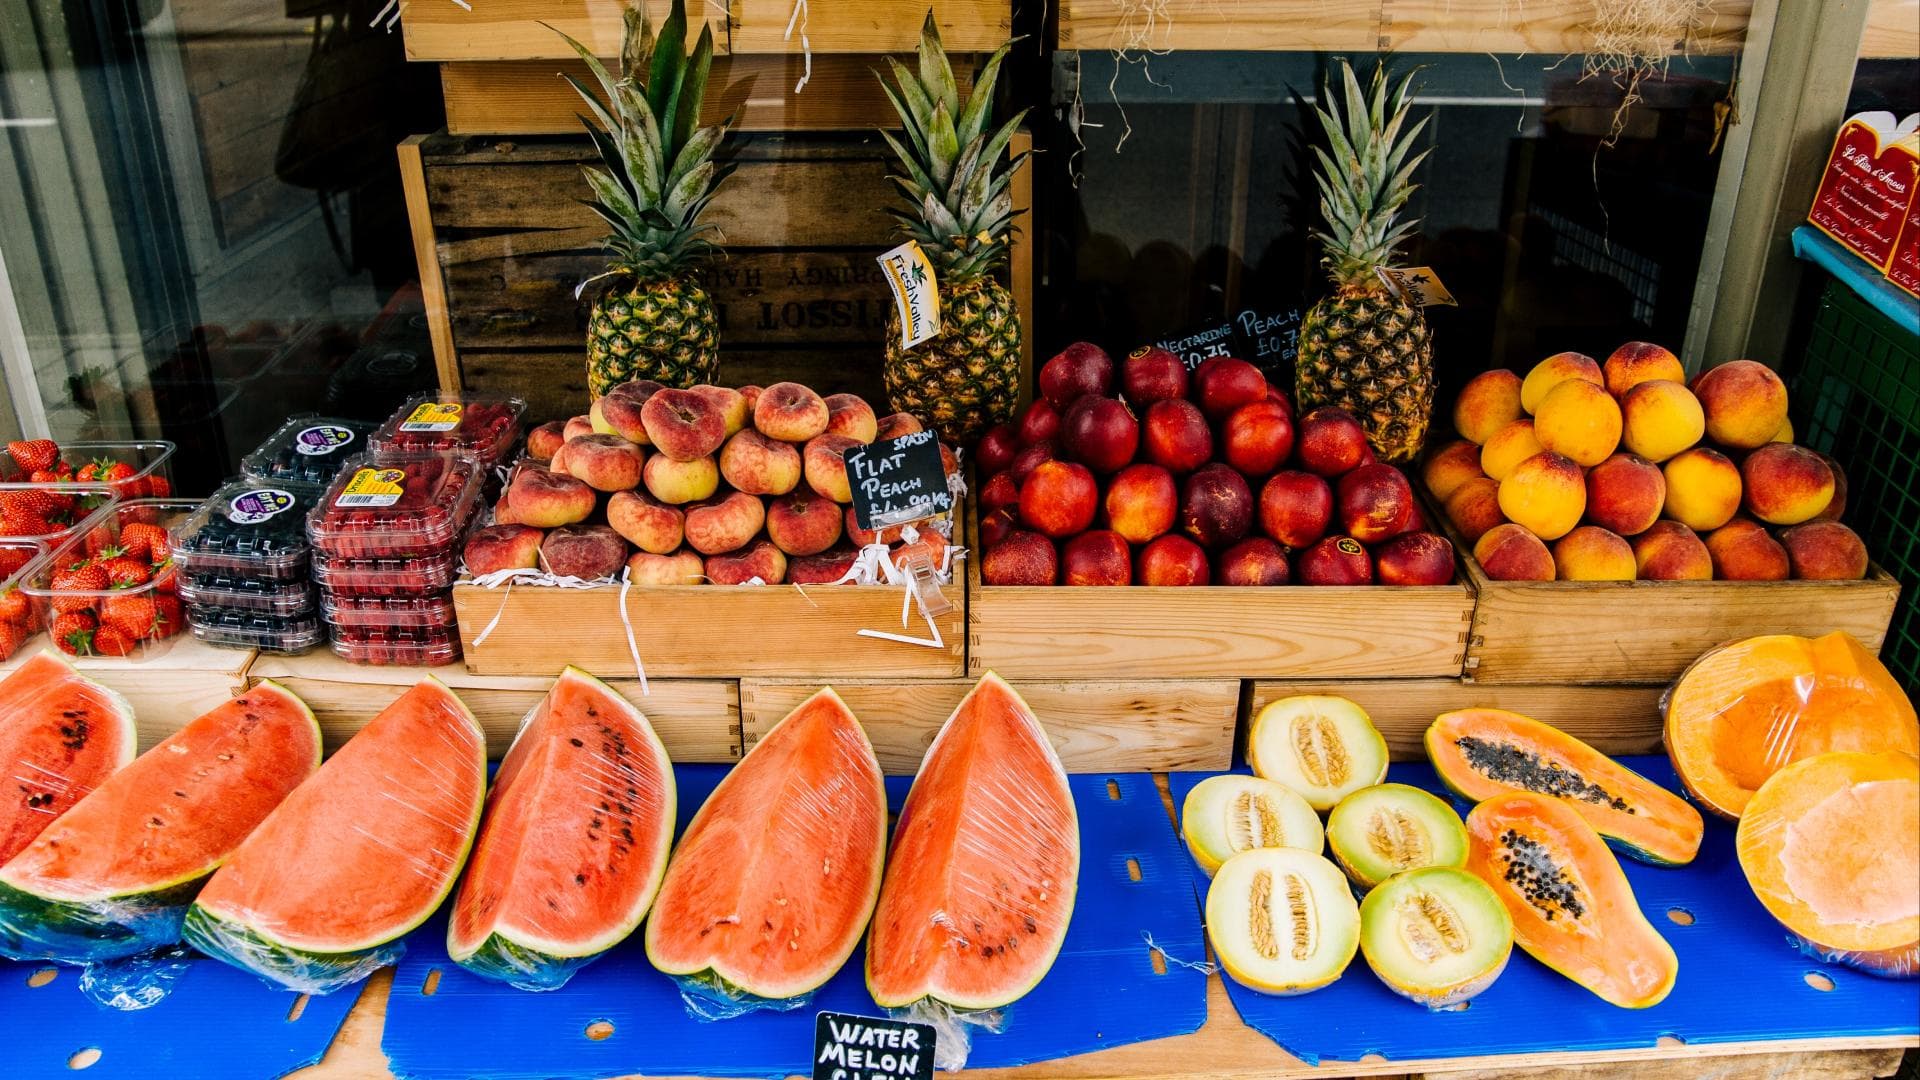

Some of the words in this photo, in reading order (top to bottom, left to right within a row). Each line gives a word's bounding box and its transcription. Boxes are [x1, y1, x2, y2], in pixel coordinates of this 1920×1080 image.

[892, 254, 921, 341] FreshValley
[1237, 309, 1300, 337] PEACH
[1156, 323, 1233, 353] NECTARINE
[893, 429, 933, 451] SPAIN
[848, 451, 906, 479] FLAT
[861, 477, 922, 500] PEACH
[830, 1020, 920, 1050] WATER
[818, 1042, 919, 1075] MELON
